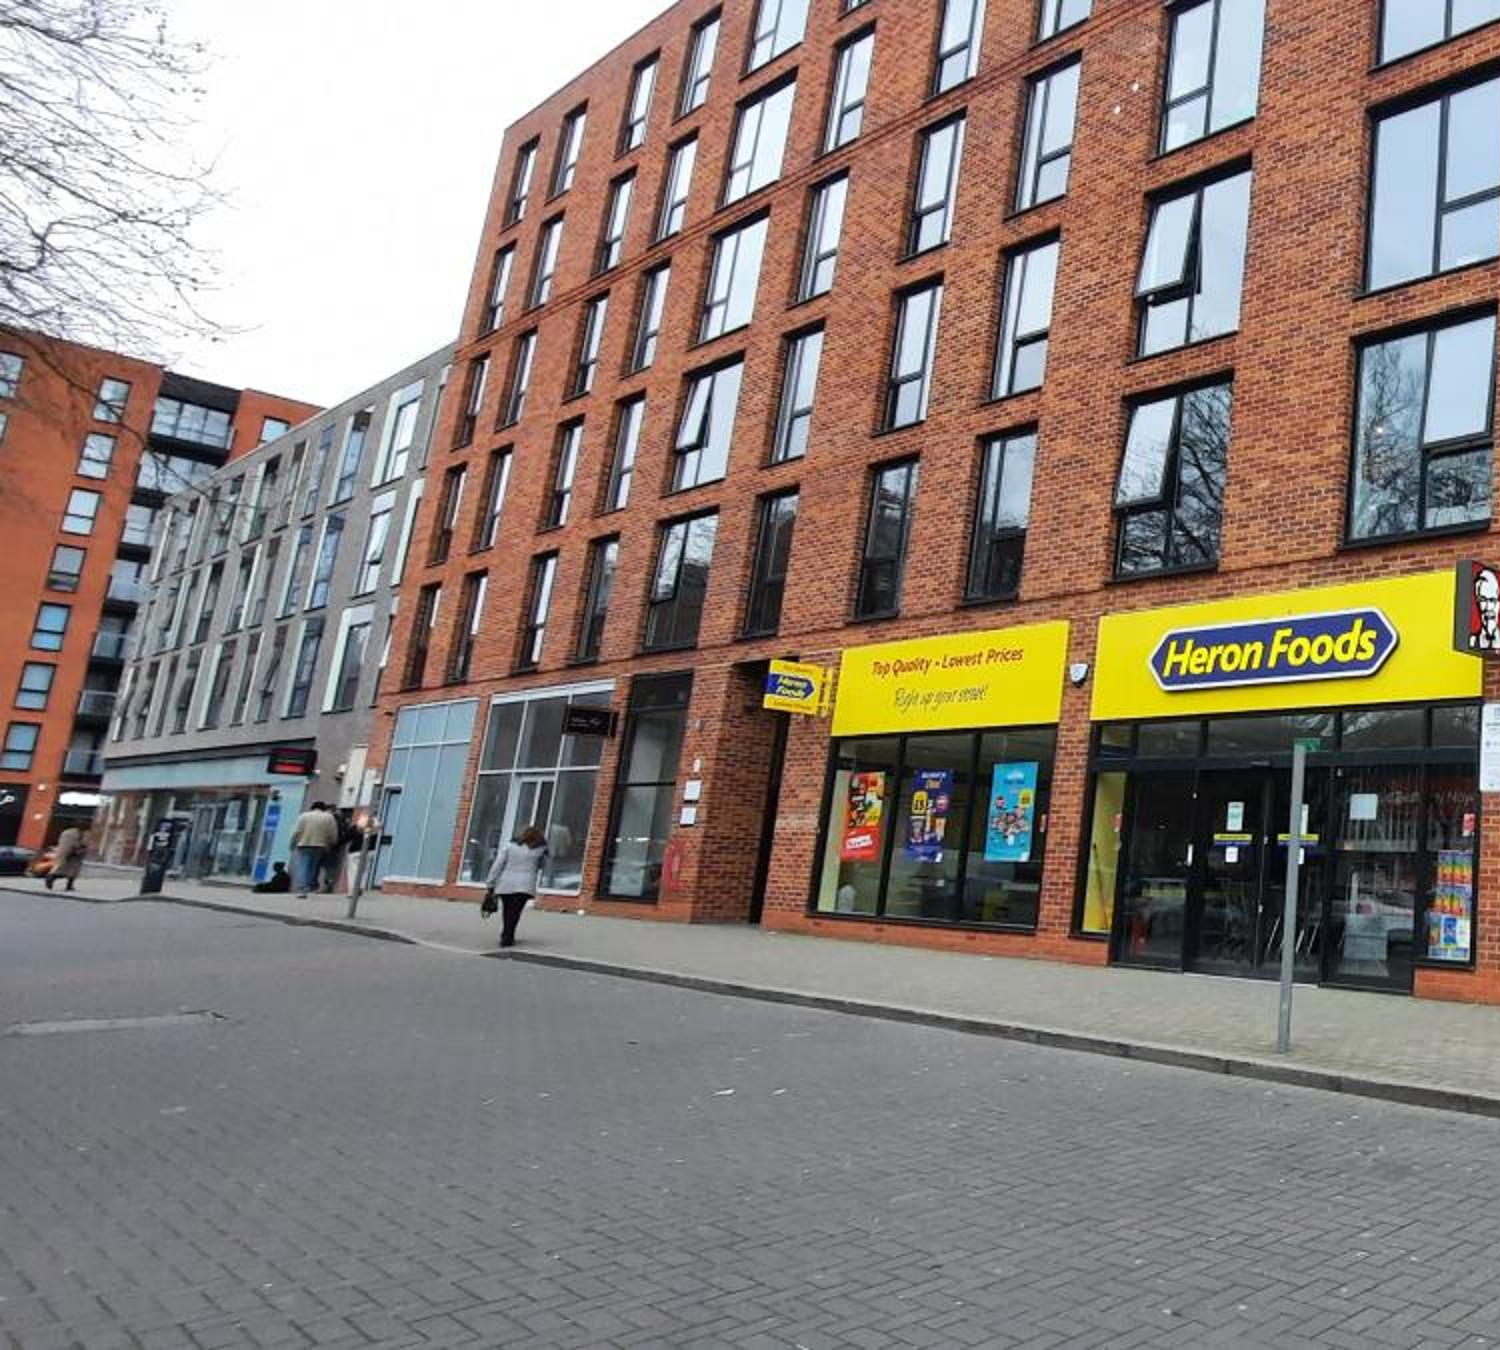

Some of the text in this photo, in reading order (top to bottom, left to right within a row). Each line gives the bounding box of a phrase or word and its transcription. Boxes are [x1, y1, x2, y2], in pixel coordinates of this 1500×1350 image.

[872, 661, 891, 678] Top
[892, 657, 932, 677] Quality
[941, 650, 983, 669] Lowest
[985, 647, 1025, 665] Prices
[1163, 618, 1377, 678] Heron Foods
